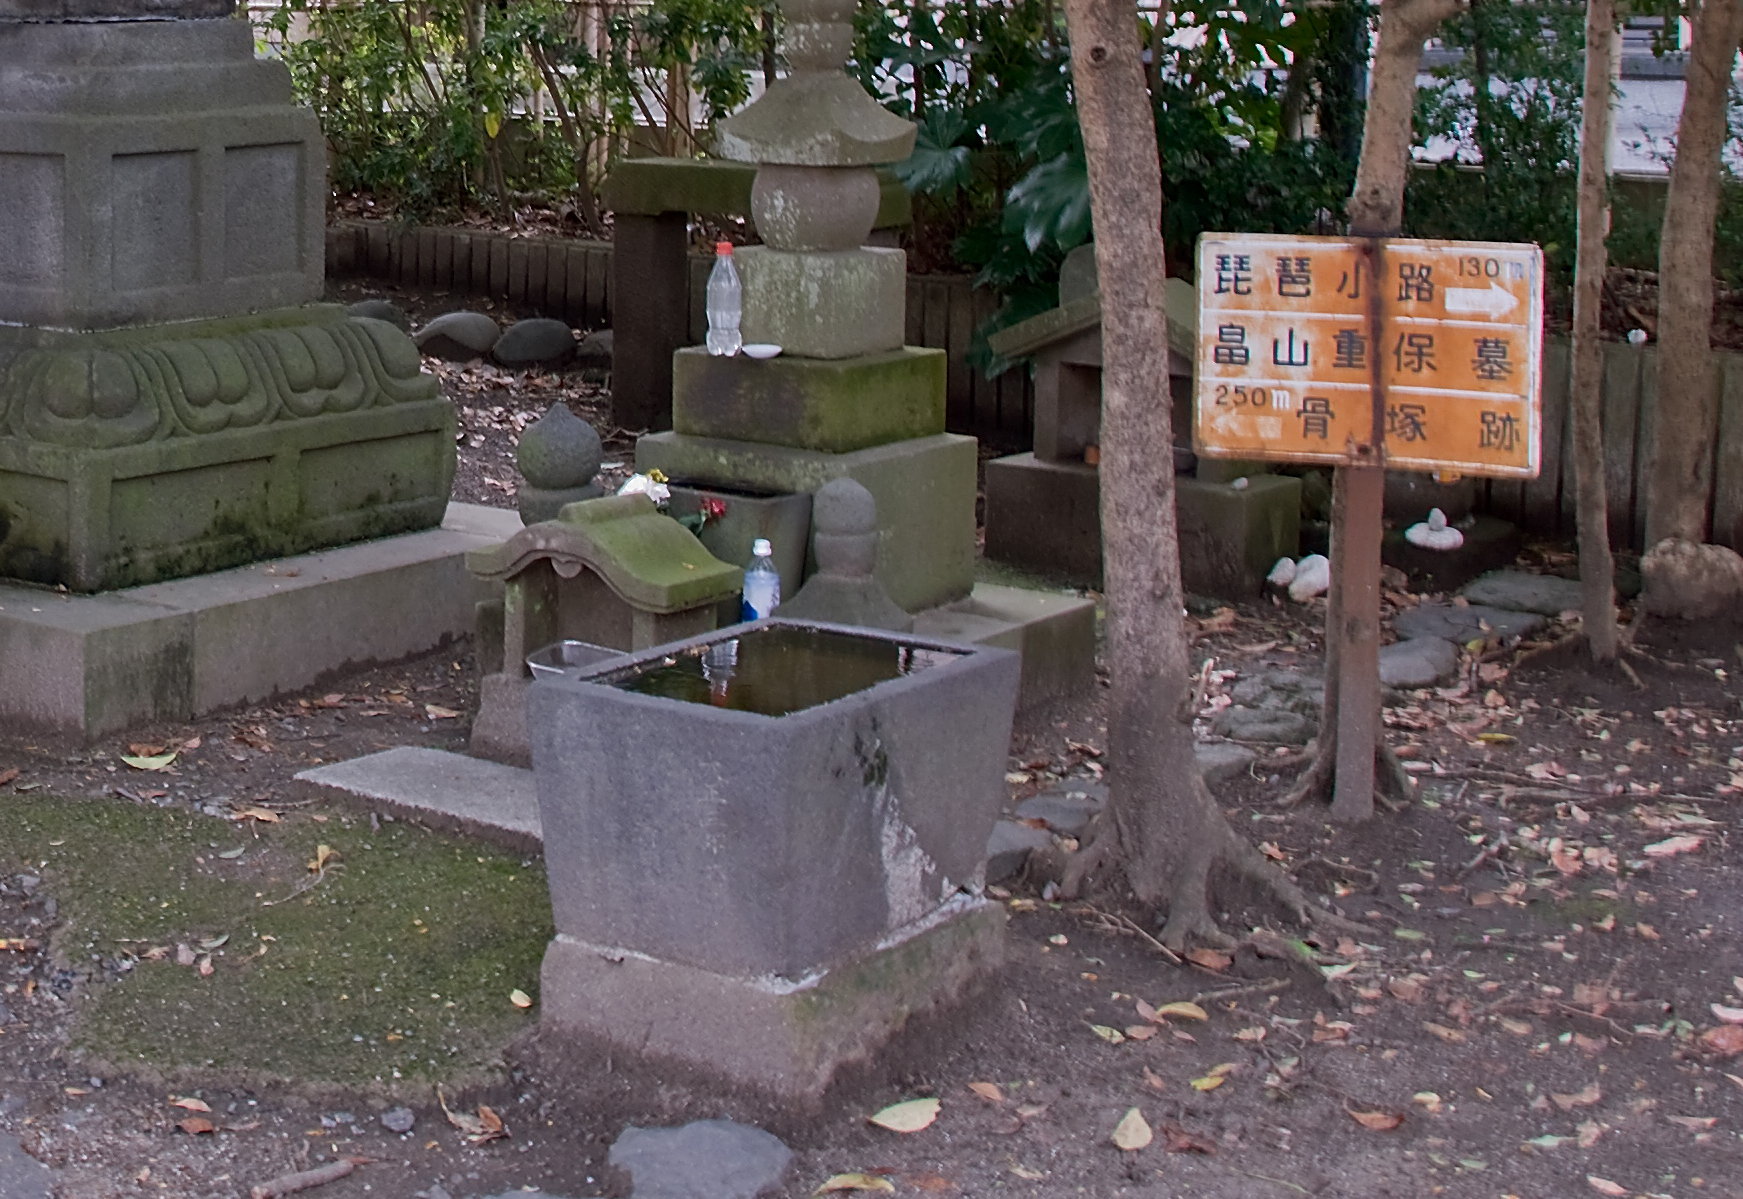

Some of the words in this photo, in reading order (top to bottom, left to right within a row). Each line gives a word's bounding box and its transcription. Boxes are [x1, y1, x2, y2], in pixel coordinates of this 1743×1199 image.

[1458, 256, 1525, 280] 130m
[1214, 322, 1514, 382] 畠山重保墓
[1214, 385, 1291, 410] 250m
[1296, 396, 1521, 451] 骨塚跡
